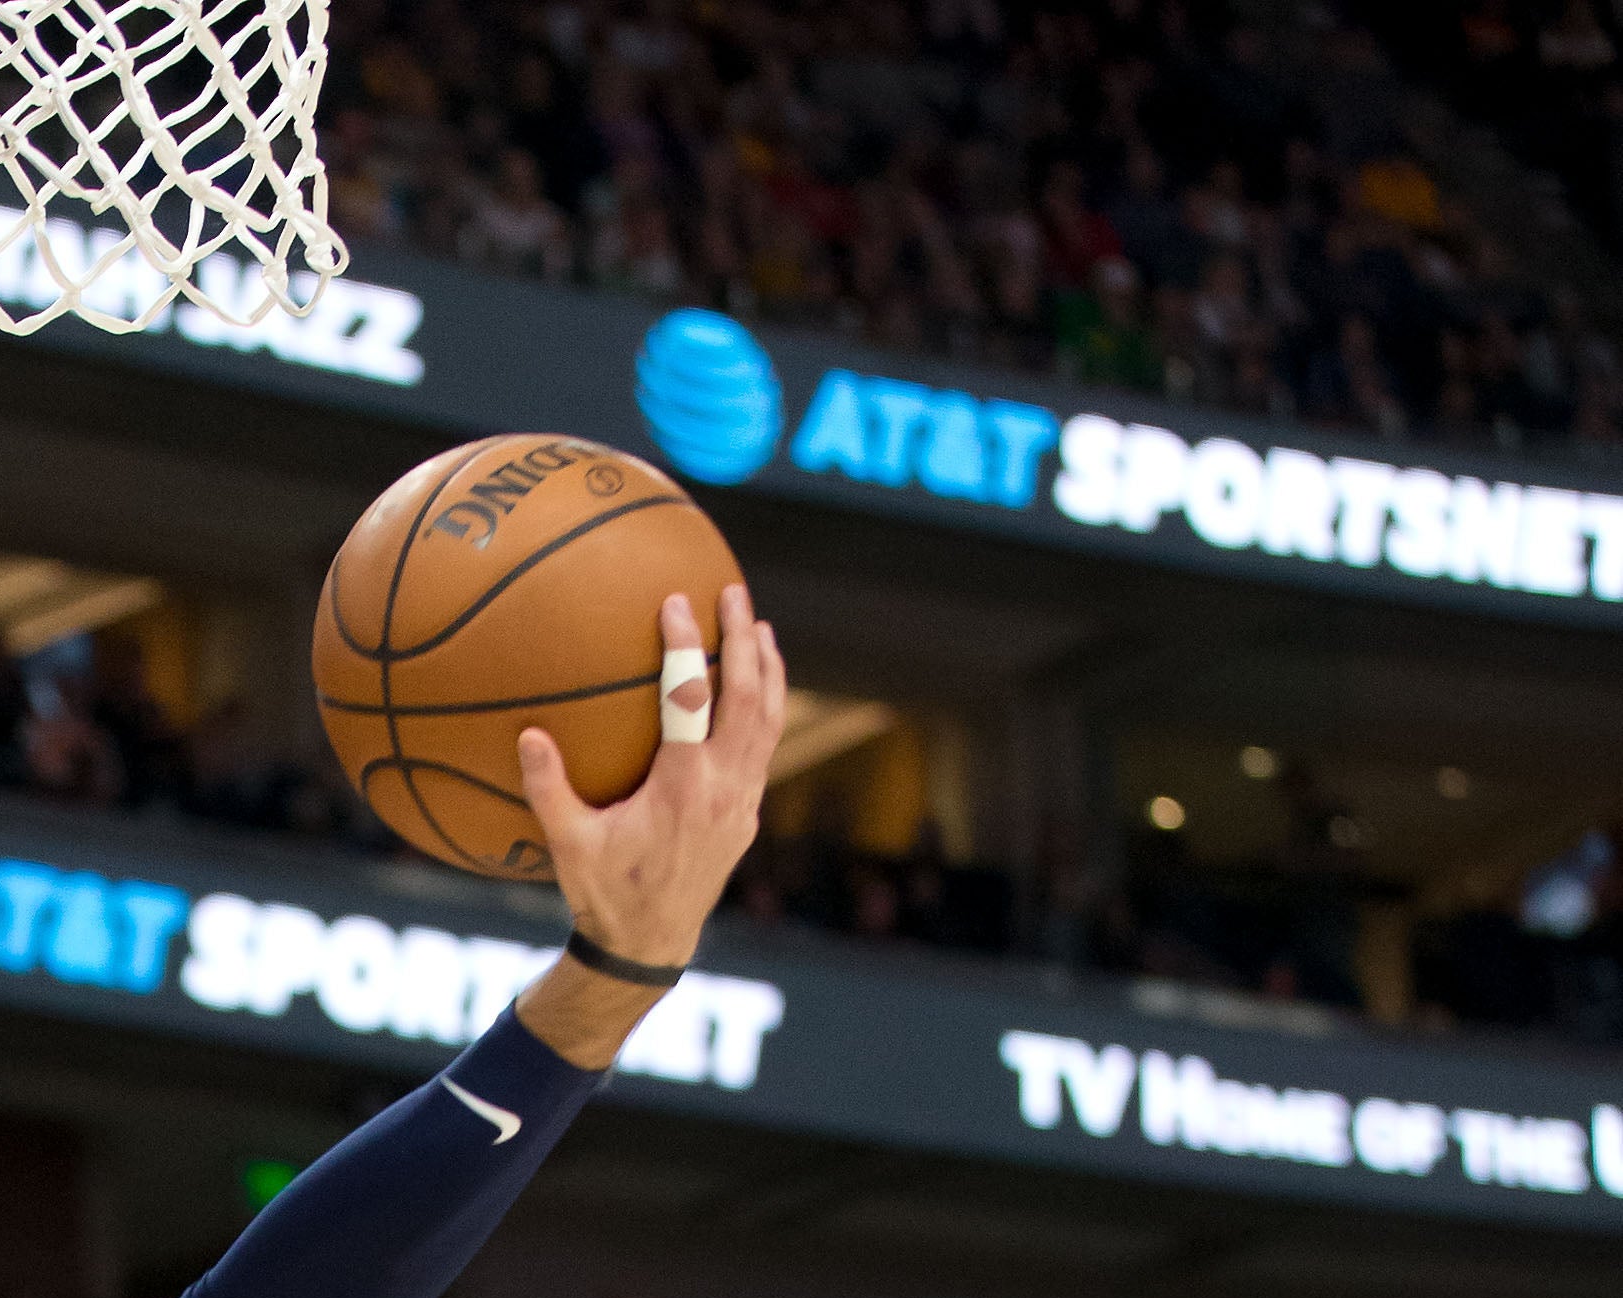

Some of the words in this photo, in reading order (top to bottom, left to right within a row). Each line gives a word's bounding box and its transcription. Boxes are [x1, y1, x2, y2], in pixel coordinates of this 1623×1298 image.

[424, 442, 580, 550] DING
[790, 368, 1060, 510] AT&T
[182, 892, 785, 1090] SPORTET
[1001, 1030, 1137, 1137] TV
[1353, 1098, 1448, 1175] OF
[1450, 1109, 1590, 1193] THE
